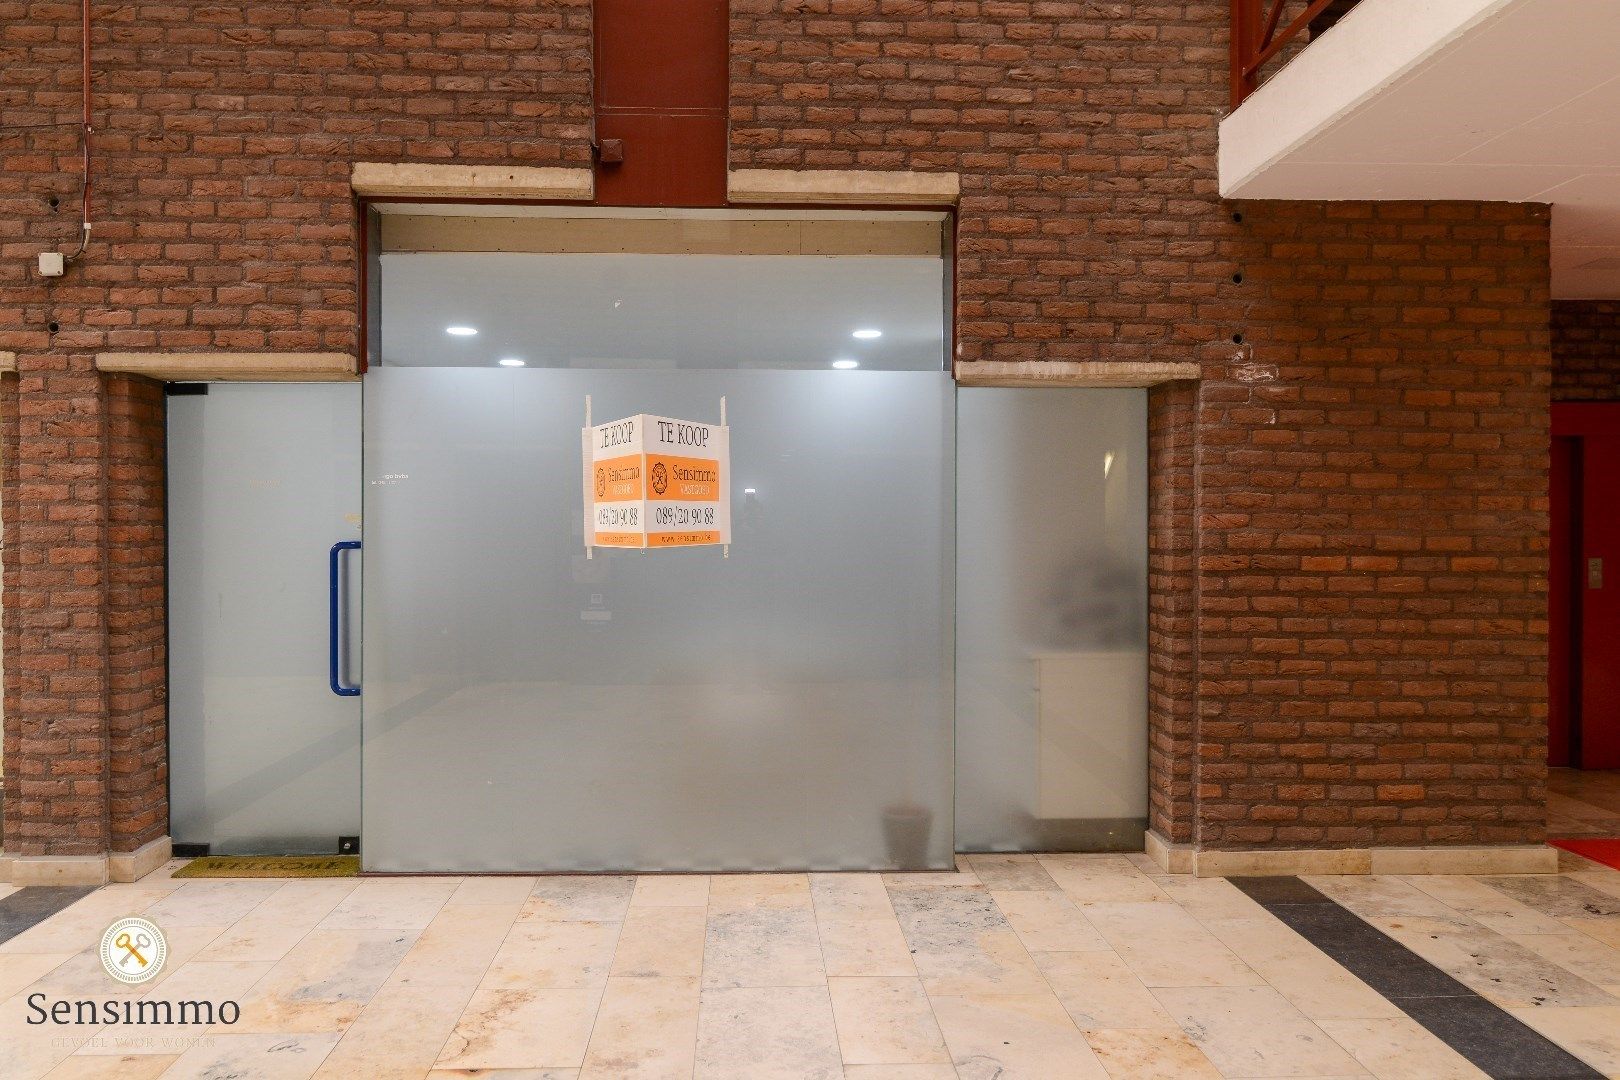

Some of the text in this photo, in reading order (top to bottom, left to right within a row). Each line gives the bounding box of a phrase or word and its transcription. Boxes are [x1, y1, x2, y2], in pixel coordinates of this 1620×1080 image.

[600, 421, 634, 449] TE KOOP
[657, 421, 709, 448] TE KOOP
[608, 465, 640, 483] Sensimmo
[672, 464, 716, 482] Sensimmo
[656, 506, 714, 526] 089/20 90 88
